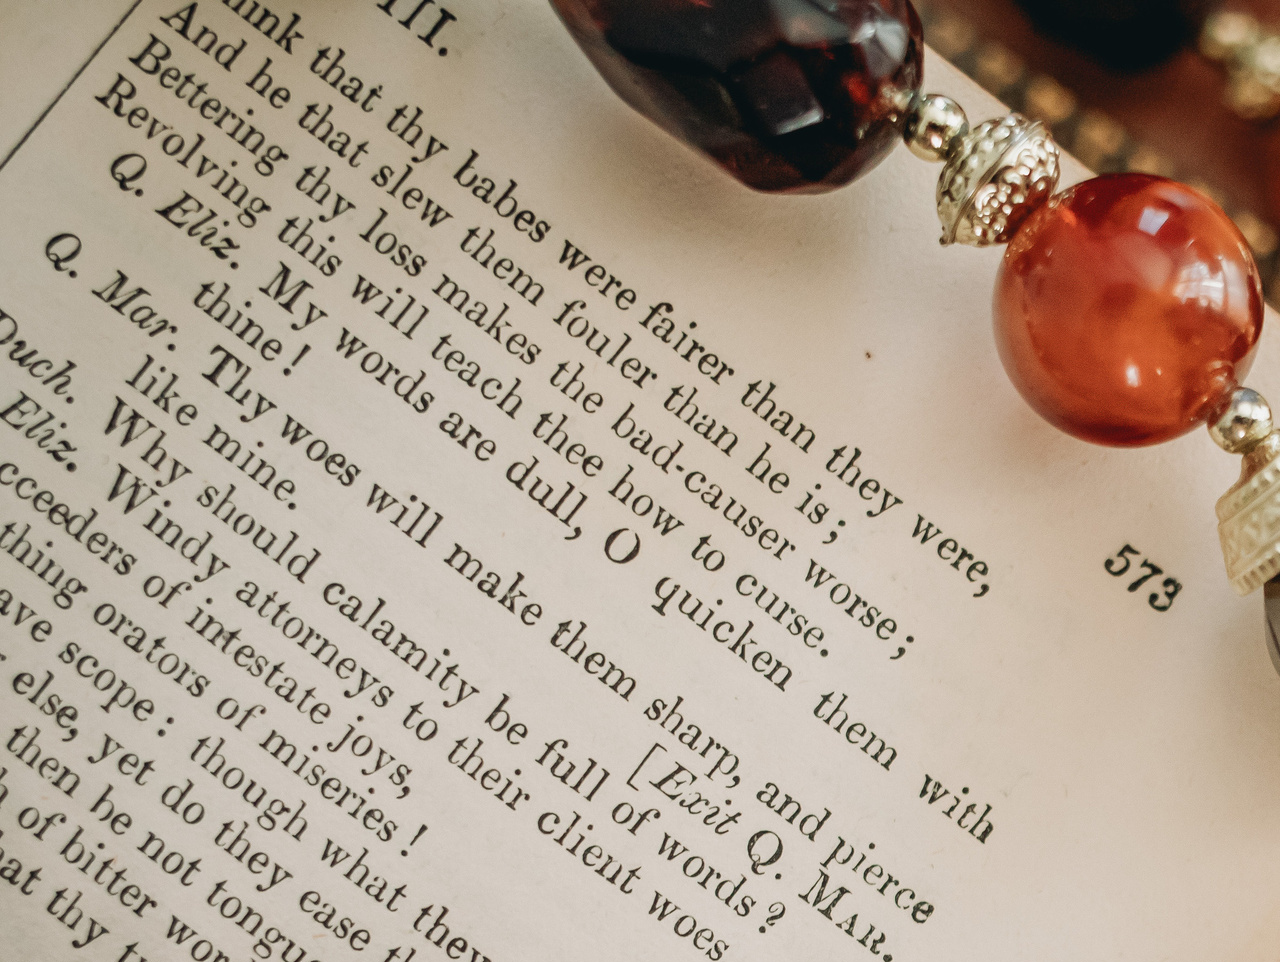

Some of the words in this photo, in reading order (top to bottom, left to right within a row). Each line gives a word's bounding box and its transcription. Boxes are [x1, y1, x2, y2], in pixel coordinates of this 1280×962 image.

[94, 73, 271, 228] Revolving
[278, 217, 342, 276] this
[352, 274, 429, 339] will
[432, 334, 522, 419] teach
[533, 412, 603, 477] thee
[608, 464, 684, 536] how
[691, 535, 725, 571] to
[736, 575, 828, 657] curse.
[128, 33, 289, 177] Bettering
[296, 166, 356, 222] thy
[359, 208, 427, 277] loss
[432, 274, 541, 364] makes
[550, 361, 603, 413] the
[611, 402, 795, 560] bad-causer
[805, 559, 914, 660] worse;
[159, 2, 247, 72] And
[246, 57, 291, 109] he
[298, 104, 369, 167] that
[371, 164, 453, 227] slew
[460, 227, 544, 306] them
[553, 300, 657, 389] fouler
[664, 385, 738, 457] than
[745, 442, 789, 493] he
[795, 484, 846, 544] is;
[194, 282, 311, 376] thine!
[310, 47, 383, 112] that
[387, 105, 449, 163] thy
[453, 149, 551, 242] babes
[559, 239, 636, 310] were
[639, 302, 734, 385] fairer
[741, 380, 815, 453] than
[826, 445, 903, 517] they
[912, 514, 989, 597] were,
[110, 153, 147, 197] Q.
[155, 191, 240, 269] Eliz.
[259, 261, 328, 331] My
[336, 327, 435, 413] words
[439, 412, 496, 461] are
[506, 456, 588, 540] dull,
[604, 528, 640, 564] O
[651, 577, 792, 692] quicken
[814, 692, 897, 771] them
[919, 774, 993, 844] with
[125, 354, 198, 426] like
[202, 424, 296, 510] mine.
[0, 391, 77, 472] Eliz.
[107, 463, 230, 582] Windy
[236, 582, 394, 707] attorneys
[403, 702, 438, 741] to
[448, 737, 530, 811] their
[538, 811, 641, 894] client
[45, 233, 82, 278] Q.
[91, 270, 177, 351] Mar.
[202, 345, 277, 422] Thy
[281, 414, 361, 486] woes
[367, 484, 443, 548] will
[444, 543, 542, 625] make
[550, 620, 636, 701] them
[643, 696, 740, 788] sharp,
[756, 782, 832, 842] and
[820, 836, 934, 924] pierce
[104, 396, 192, 487] Why
[197, 484, 321, 584] should
[323, 583, 480, 708] calamity
[485, 693, 528, 744] be
[535, 739, 610, 801] full
[612, 803, 661, 836] of
[658, 832, 785, 933] words?
[143, 576, 192, 608] of
[185, 598, 331, 724] intestate
[327, 715, 412, 799] joys,
[1104, 544, 1182, 612] 573
[7, 727, 81, 798] then
[91, 786, 133, 836] be
[138, 833, 202, 887] not
[12, 670, 78, 742] else,
[87, 734, 155, 786] yet
[161, 779, 204, 824] do
[215, 821, 293, 892] they
[299, 891, 370, 951] ease
[19, 808, 67, 841] of
[60, 826, 157, 917] bitter
[58, 642, 174, 737] scope:
[191, 737, 307, 841] though
[321, 838, 407, 912] what
[93, 603, 211, 697] orators
[217, 699, 267, 731] of
[260, 731, 429, 857] miseries!
[626, 743, 742, 835] [Exit
[747, 830, 783, 880] Q.
[47, 888, 109, 948] thy
